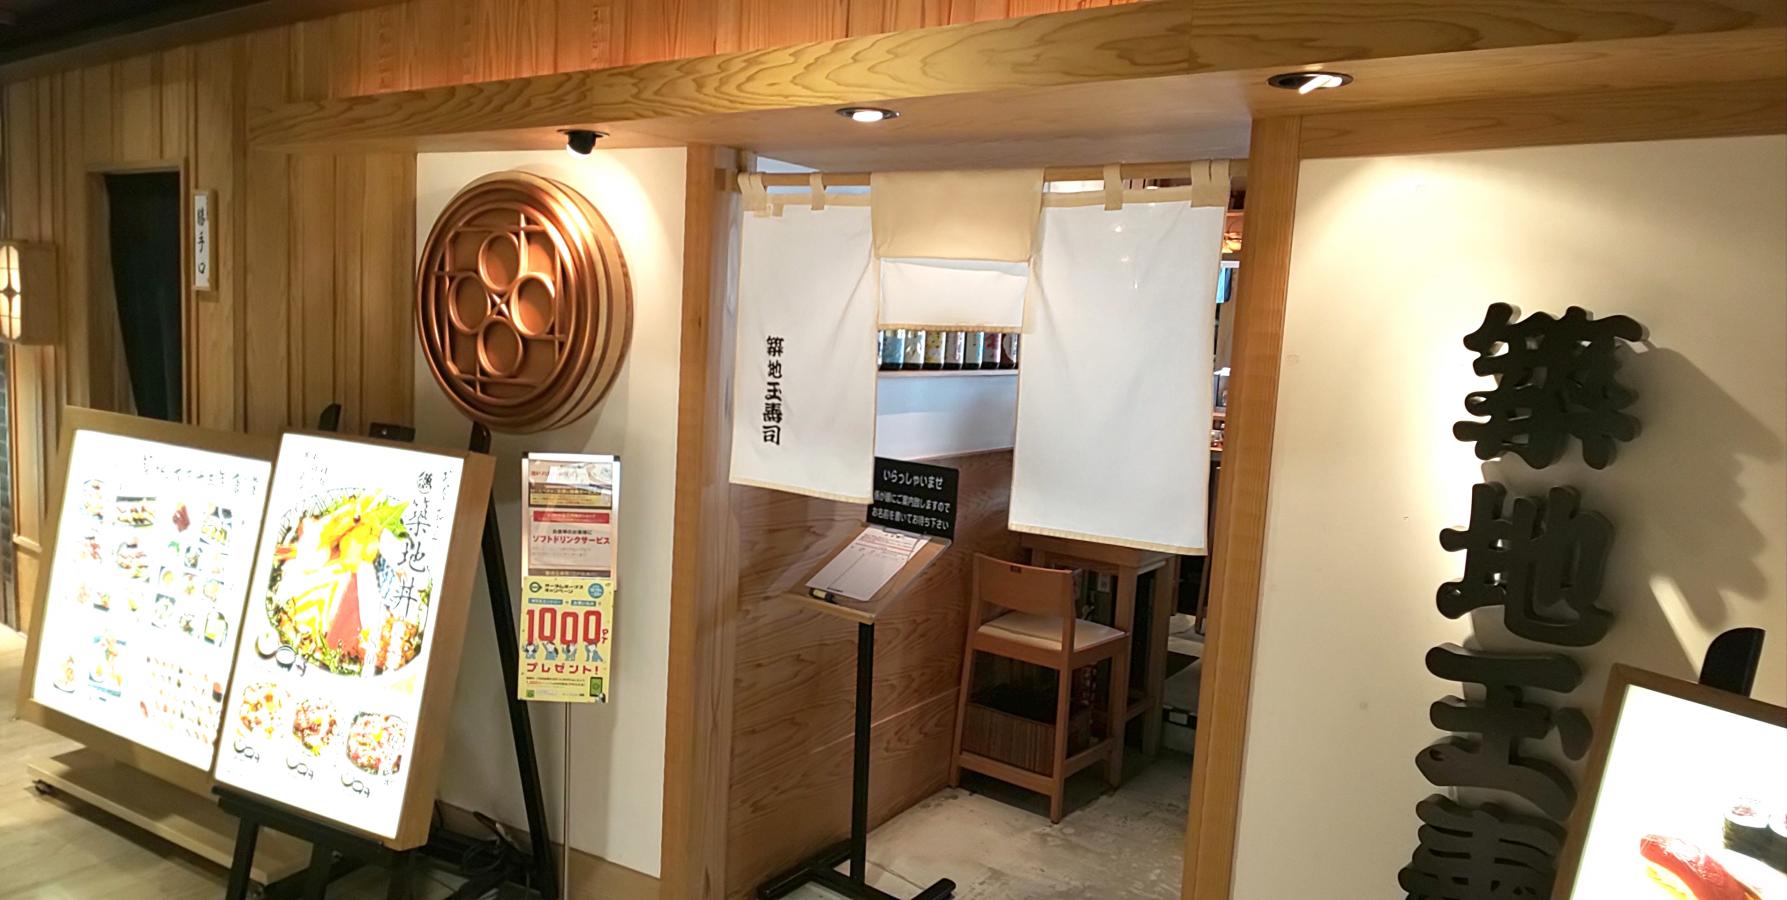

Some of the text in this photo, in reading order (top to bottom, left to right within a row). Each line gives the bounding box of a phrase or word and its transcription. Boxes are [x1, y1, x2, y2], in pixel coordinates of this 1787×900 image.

[197, 207, 206, 274] 勝手口
[883, 469, 943, 490] いらっしゃいませ
[871, 506, 949, 530] お名前を書いてお待ち下さい
[532, 535, 611, 545] ソフトドリンクサービス
[526, 607, 602, 646] 1000
[526, 662, 599, 675] プレゼント!
